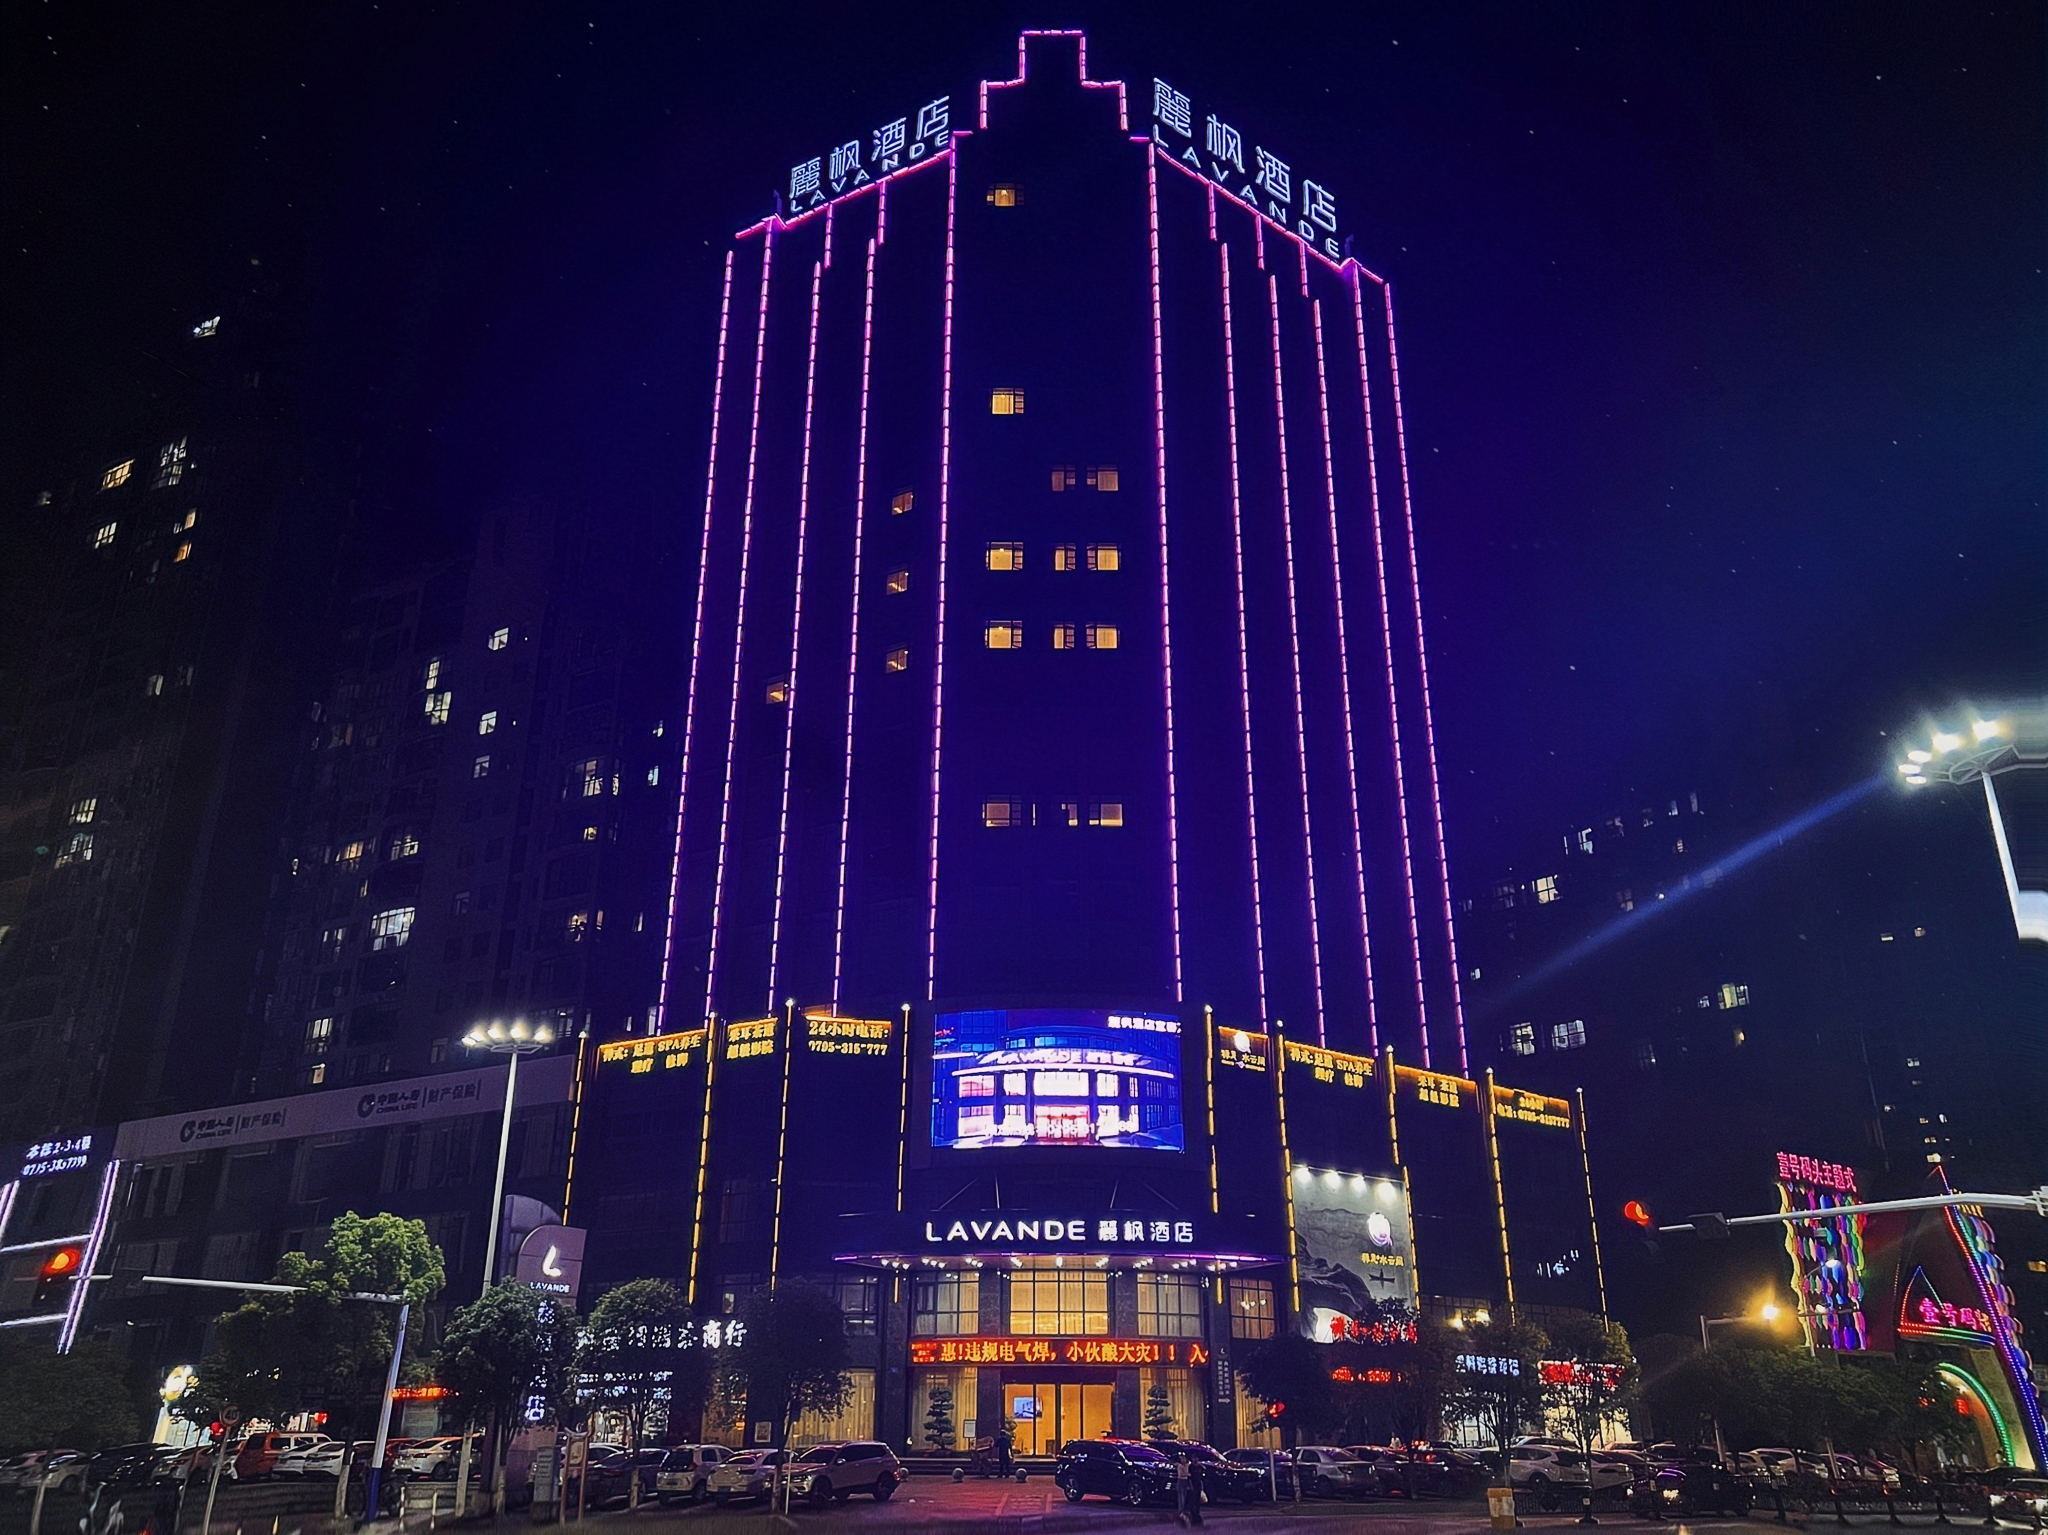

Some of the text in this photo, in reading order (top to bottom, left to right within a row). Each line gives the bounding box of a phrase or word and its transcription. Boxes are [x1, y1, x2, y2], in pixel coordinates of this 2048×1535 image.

[789, 96, 950, 200] 麗枫酒店
[790, 130, 949, 213] LAVANDE
[1152, 124, 1340, 258] LAVANDE
[1153, 77, 1337, 233] 麗枫酒店
[924, 1220, 1194, 1243] LAVANDE 麗枫酒店
[529, 1281, 571, 1294] LAVANDE
